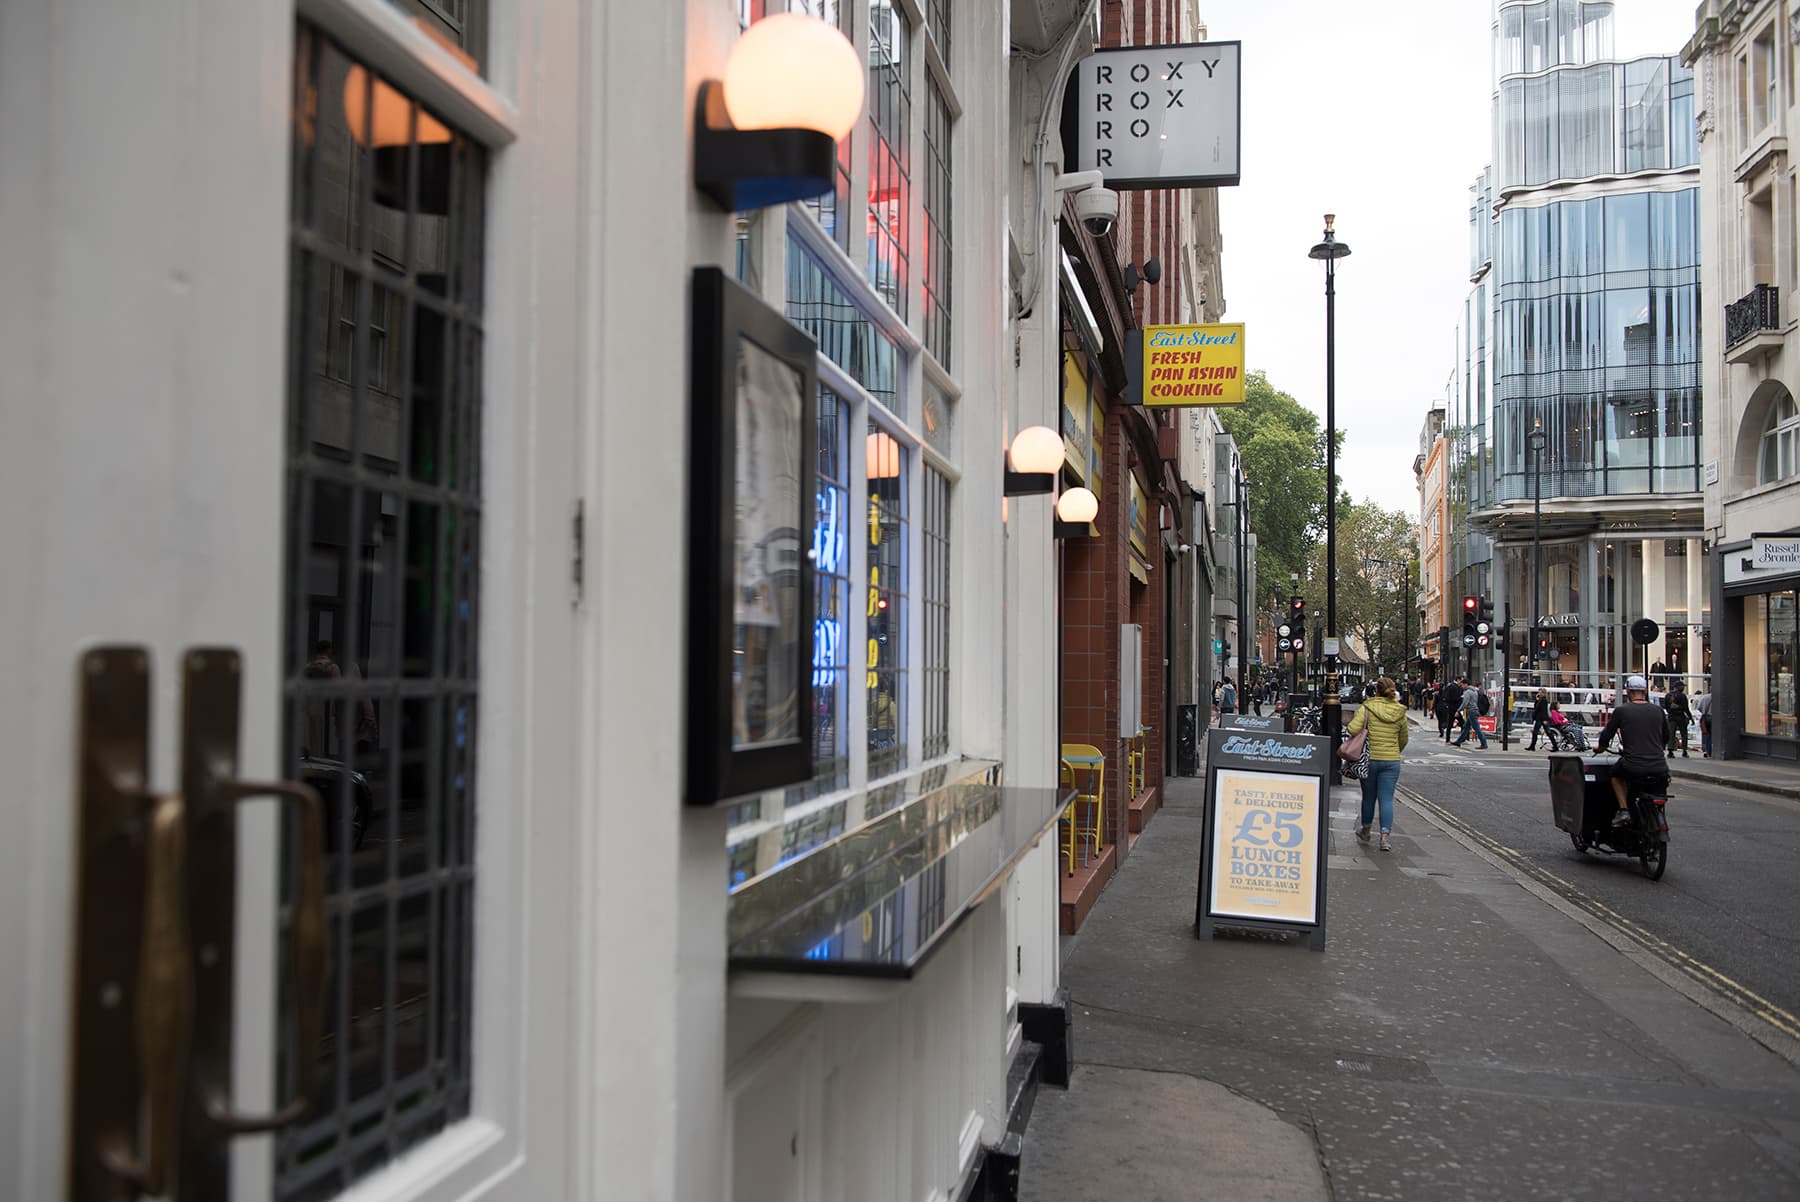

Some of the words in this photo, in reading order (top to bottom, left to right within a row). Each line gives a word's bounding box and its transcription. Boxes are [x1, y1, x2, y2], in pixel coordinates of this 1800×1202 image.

[1096, 59, 1220, 84] ROXY
[1096, 149, 1113, 167] R
[1150, 331, 1185, 346] East
[1186, 330, 1237, 346] Street
[1151, 351, 1202, 365] FRESH
[1151, 367, 1184, 381] PAN
[1188, 366, 1238, 380] ASIAN
[1150, 383, 1224, 397] COOKING
[1764, 543, 1799, 553] Russell
[1759, 553, 1800, 563] Bromle
[1537, 615, 1580, 625] ZARA
[1221, 736, 1260, 755] East
[1260, 739, 1313, 759] Street
[1269, 792, 1304, 801] FRESH
[1245, 798, 1304, 810] DELICIOUS
[1231, 809, 1304, 848] £5
[1231, 846, 1302, 865] LUNCH
[1230, 861, 1302, 881] BOXES
[1230, 877, 1243, 885] TO
[1246, 878, 1272, 888] TAKE
[1274, 881, 1301, 890] AWAY
